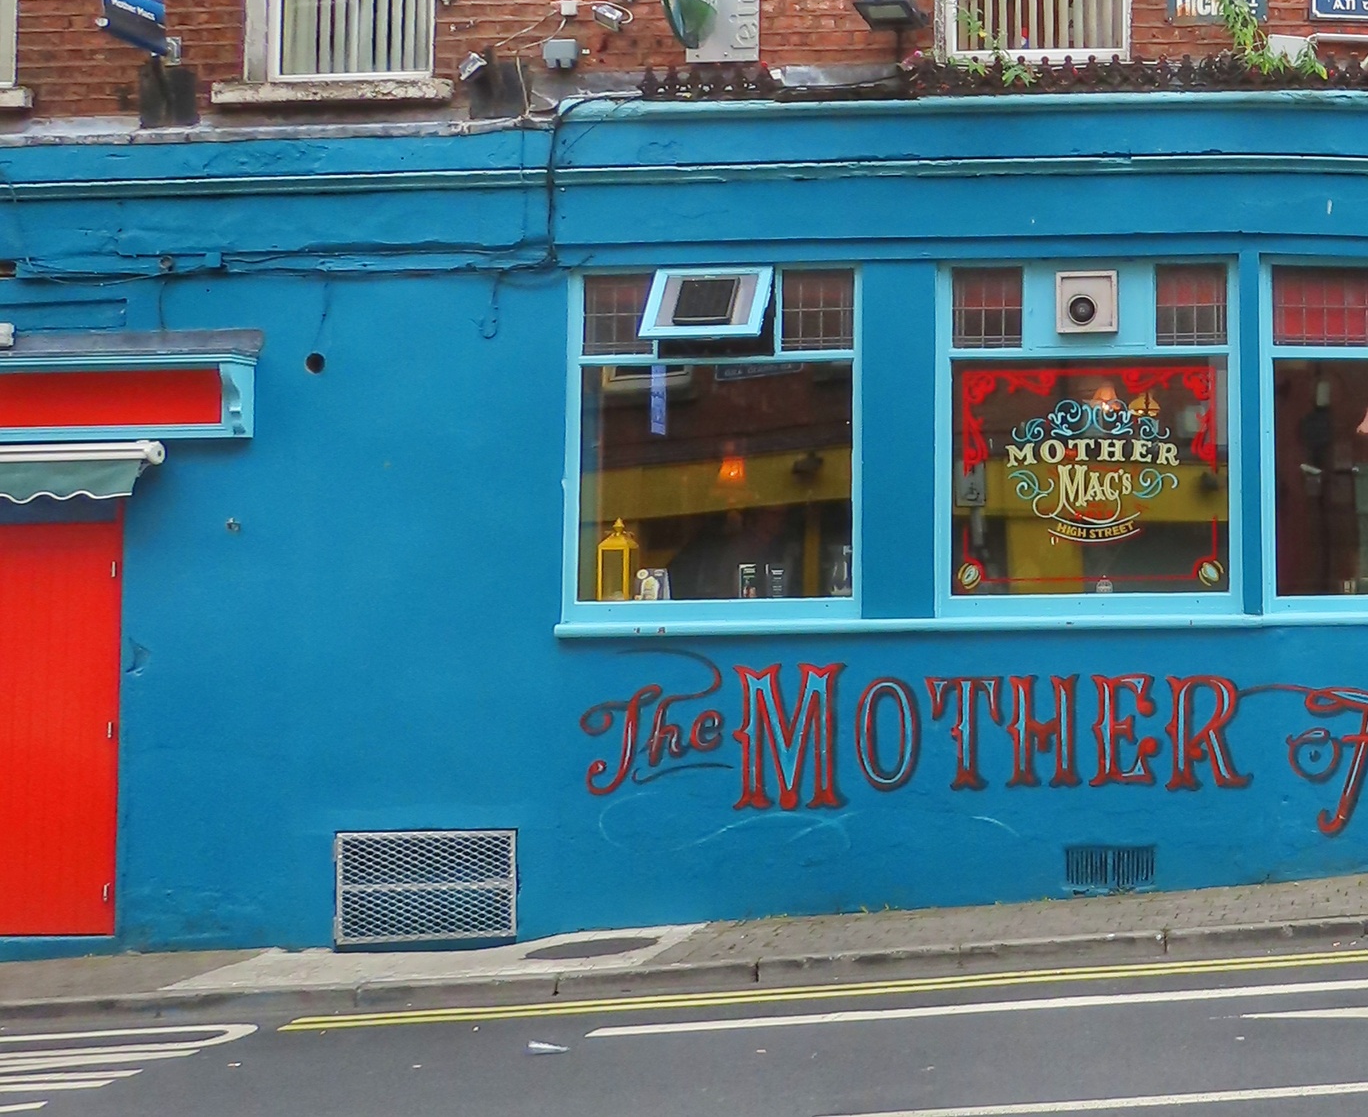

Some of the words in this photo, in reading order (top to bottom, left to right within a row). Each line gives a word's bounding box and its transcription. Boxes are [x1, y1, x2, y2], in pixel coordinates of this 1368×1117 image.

[1005, 439, 1180, 467] MOTHER
[1057, 522, 1087, 538] HIGH
[1089, 521, 1135, 539] STREET
[579, 675, 724, 795] The
[733, 662, 1255, 811] MOTHER
